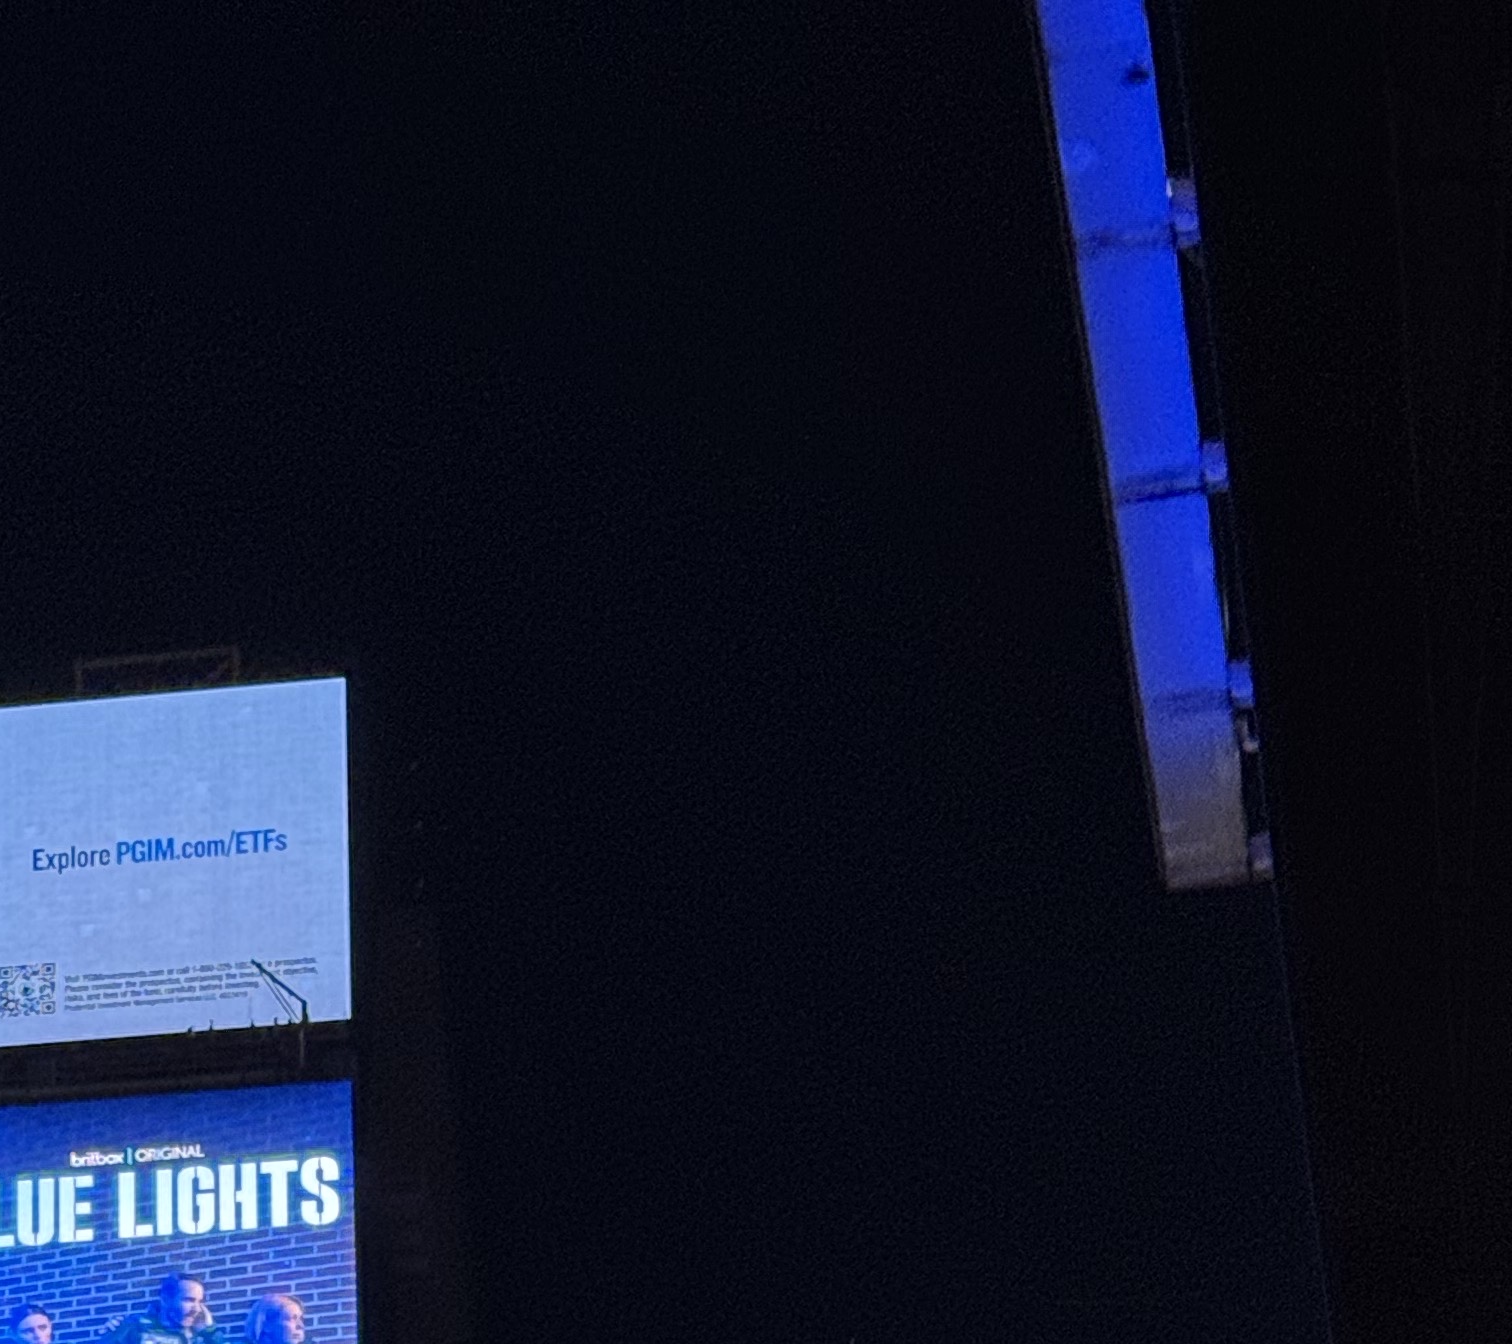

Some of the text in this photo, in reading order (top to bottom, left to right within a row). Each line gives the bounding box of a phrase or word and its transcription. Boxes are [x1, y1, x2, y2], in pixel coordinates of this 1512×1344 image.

[32, 828, 288, 875] Explore PGIM.com/ETFs
[69, 1143, 205, 1168] britbox ORIGINAL
[117, 1155, 342, 1239] LIGHTS
